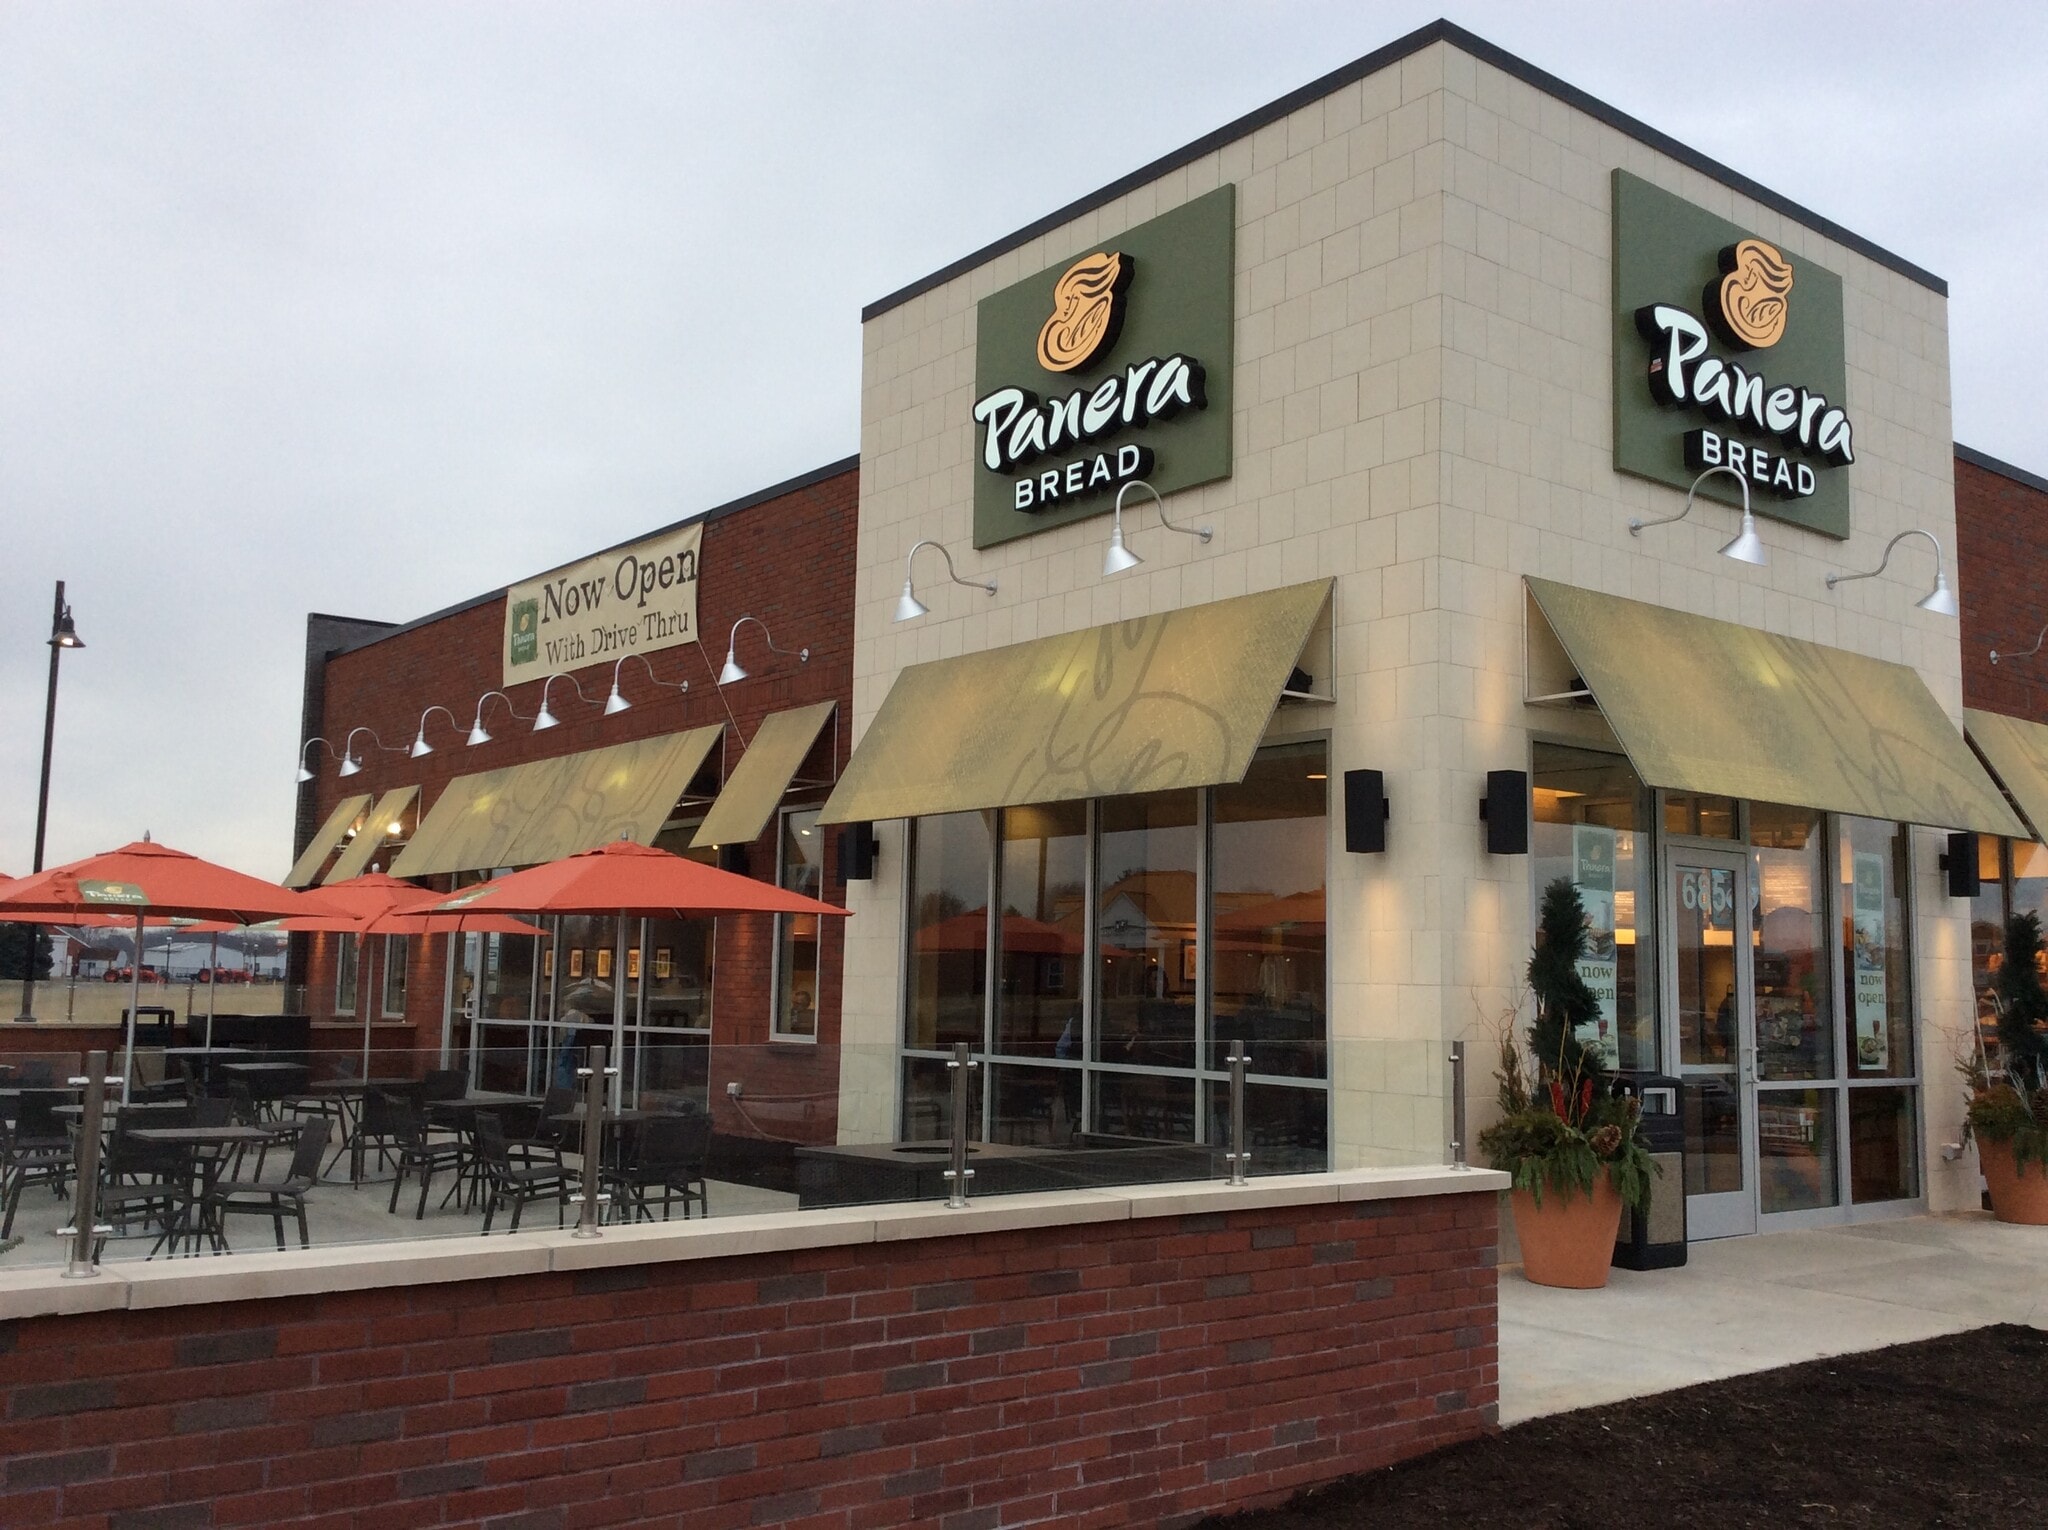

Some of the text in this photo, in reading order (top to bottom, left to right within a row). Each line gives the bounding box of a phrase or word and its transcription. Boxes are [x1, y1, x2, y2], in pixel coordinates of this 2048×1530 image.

[974, 356, 1191, 469] Panera
[1653, 305, 1853, 461] Panera
[1015, 444, 1140, 509] BREAD
[1702, 430, 1815, 496] BREAD
[541, 548, 697, 624] Now Open
[545, 609, 689, 666] With Drive Thru
[1581, 966, 1613, 978] now
[1858, 992, 1885, 1007] open
[1860, 974, 1883, 986] now
